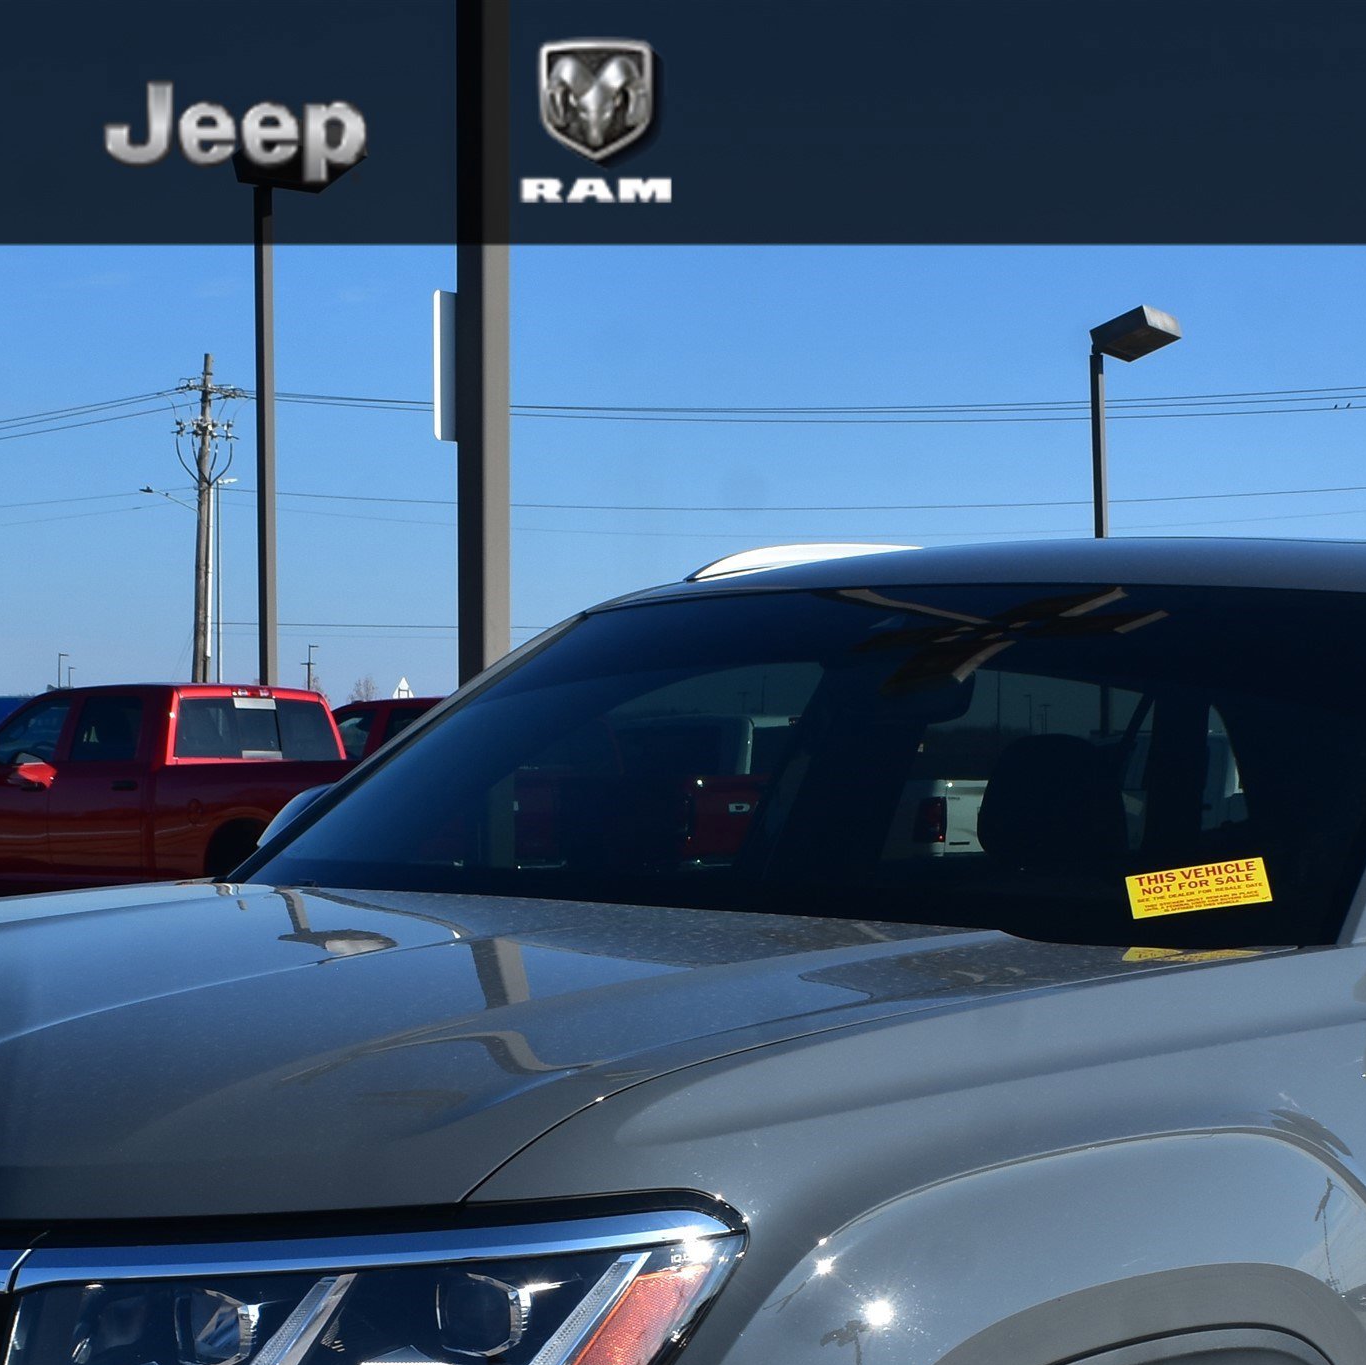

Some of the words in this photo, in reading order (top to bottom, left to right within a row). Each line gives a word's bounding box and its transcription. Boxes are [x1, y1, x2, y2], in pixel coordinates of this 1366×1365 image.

[1136, 872, 1176, 886] THIS
[1180, 861, 1256, 880] VEHICLE
[1142, 884, 1172, 895] NOT
[1178, 880, 1209, 890] FOR
[1215, 874, 1254, 885] SALE
